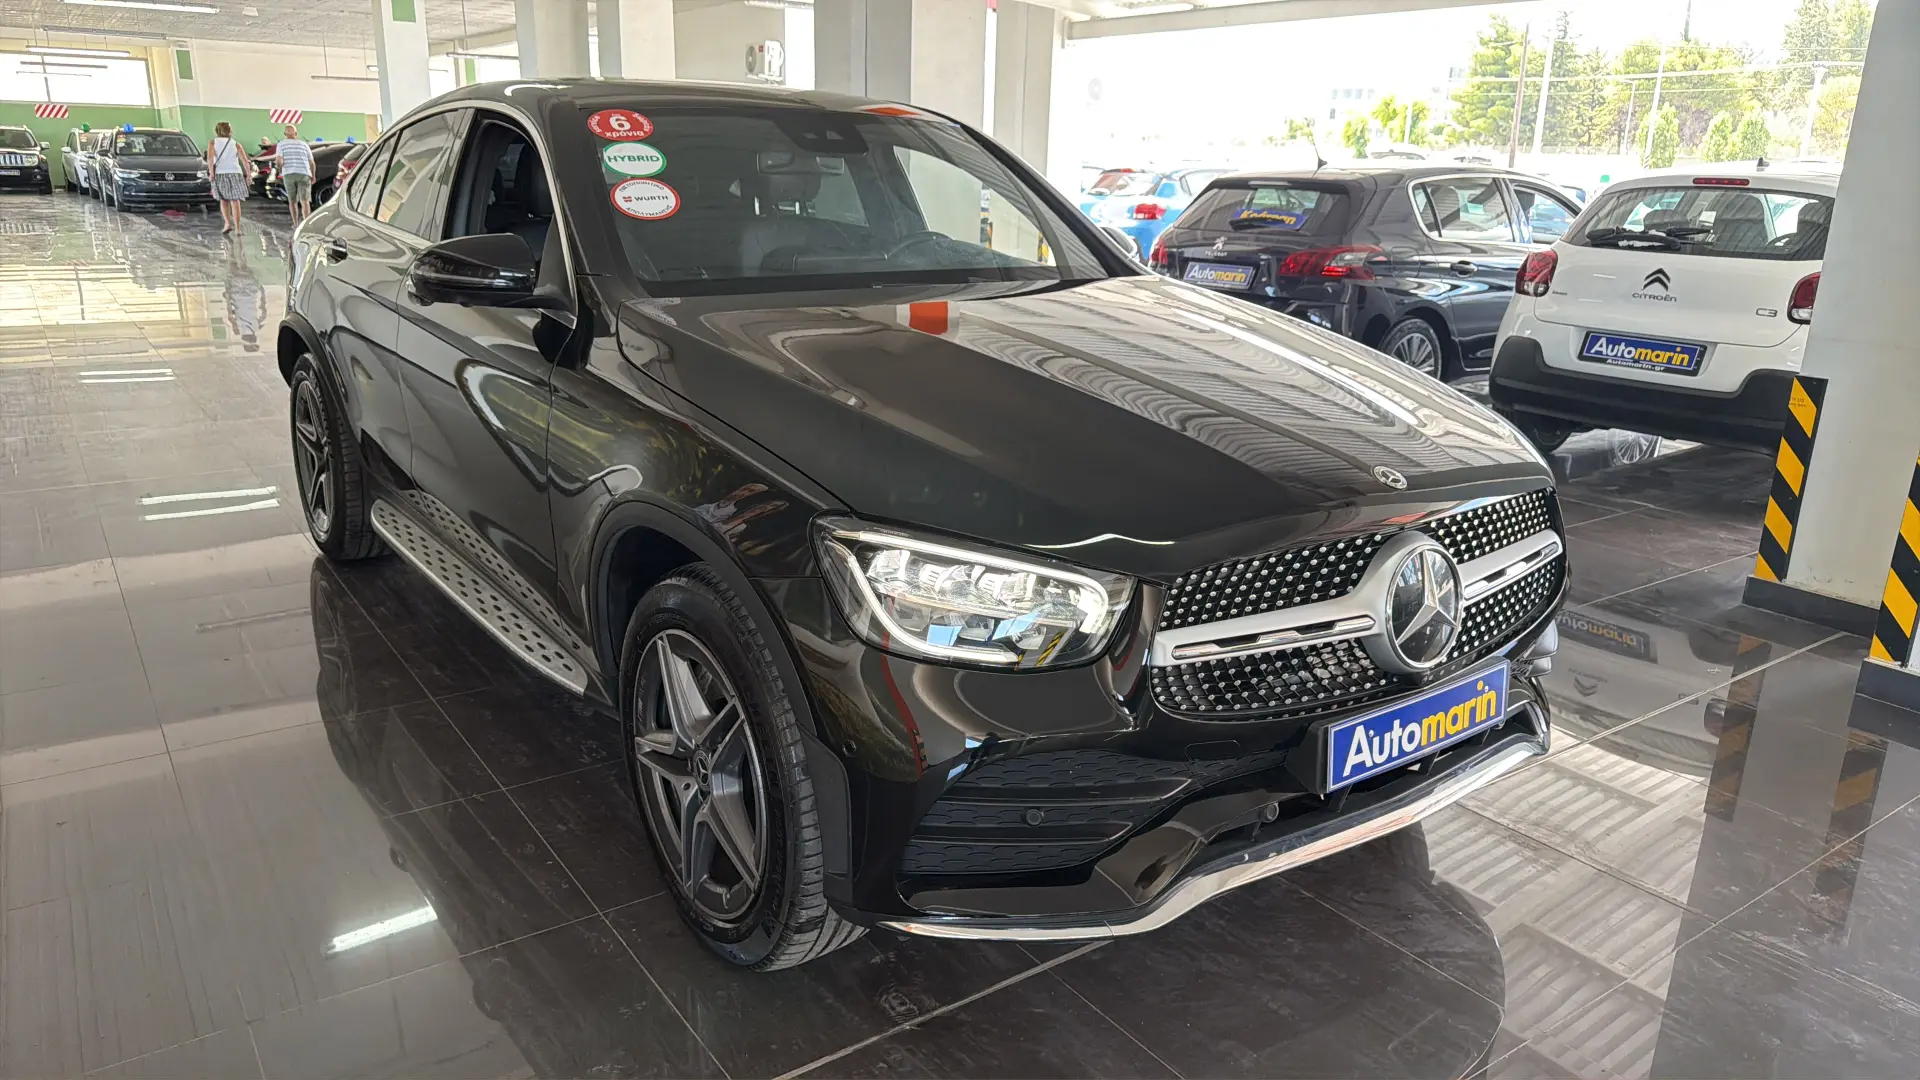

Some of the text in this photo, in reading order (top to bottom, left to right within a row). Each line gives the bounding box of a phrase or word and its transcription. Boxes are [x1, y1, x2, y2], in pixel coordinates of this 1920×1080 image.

[609, 115, 631, 131] 6
[605, 130, 645, 138] χρόνια
[607, 155, 660, 163] HYBRID
[1188, 264, 1247, 283] Automarin
[1755, 307, 1779, 318] C3
[1590, 337, 1690, 368] Automarin
[1606, 358, 1665, 372] Automarin.gr
[1342, 680, 1498, 778] Automarin
